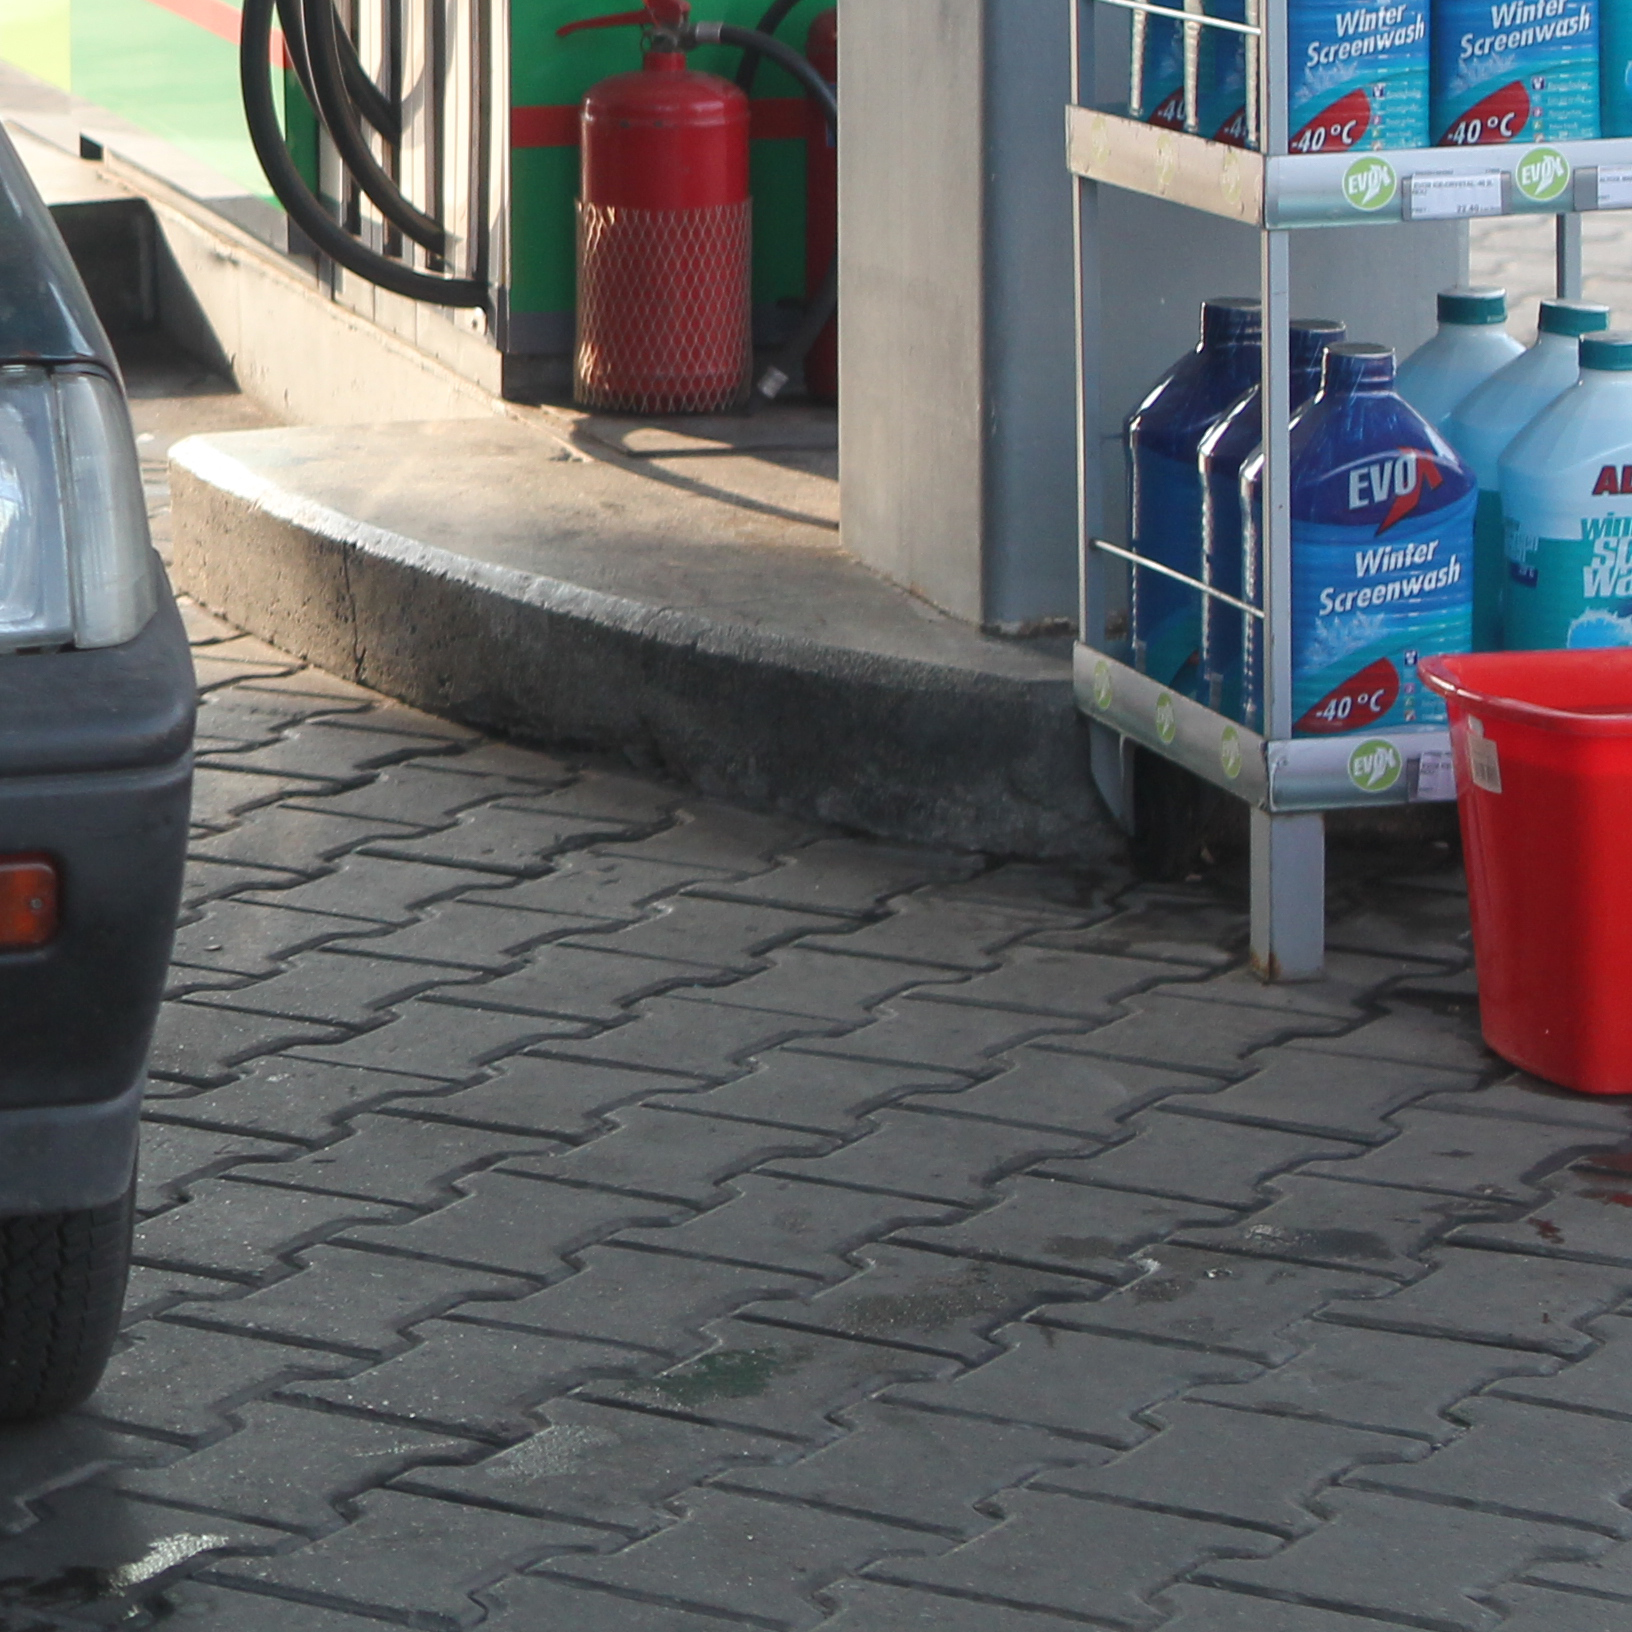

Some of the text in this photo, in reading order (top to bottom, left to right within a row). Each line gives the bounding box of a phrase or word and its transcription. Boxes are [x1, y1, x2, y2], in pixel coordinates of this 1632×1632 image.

[1336, 3, 1407, 38] Winter
[1460, 5, 1592, 59] Screenwash
[1306, 17, 1425, 68] Screenwash
[1291, 126, 1325, 153] -40
[1447, 118, 1482, 144] -40
[1355, 539, 1439, 578] Winter
[1319, 558, 1462, 617] Screenwash
[1315, 690, 1384, 721] -40 °C
[1354, 747, 1396, 787] EVOX
